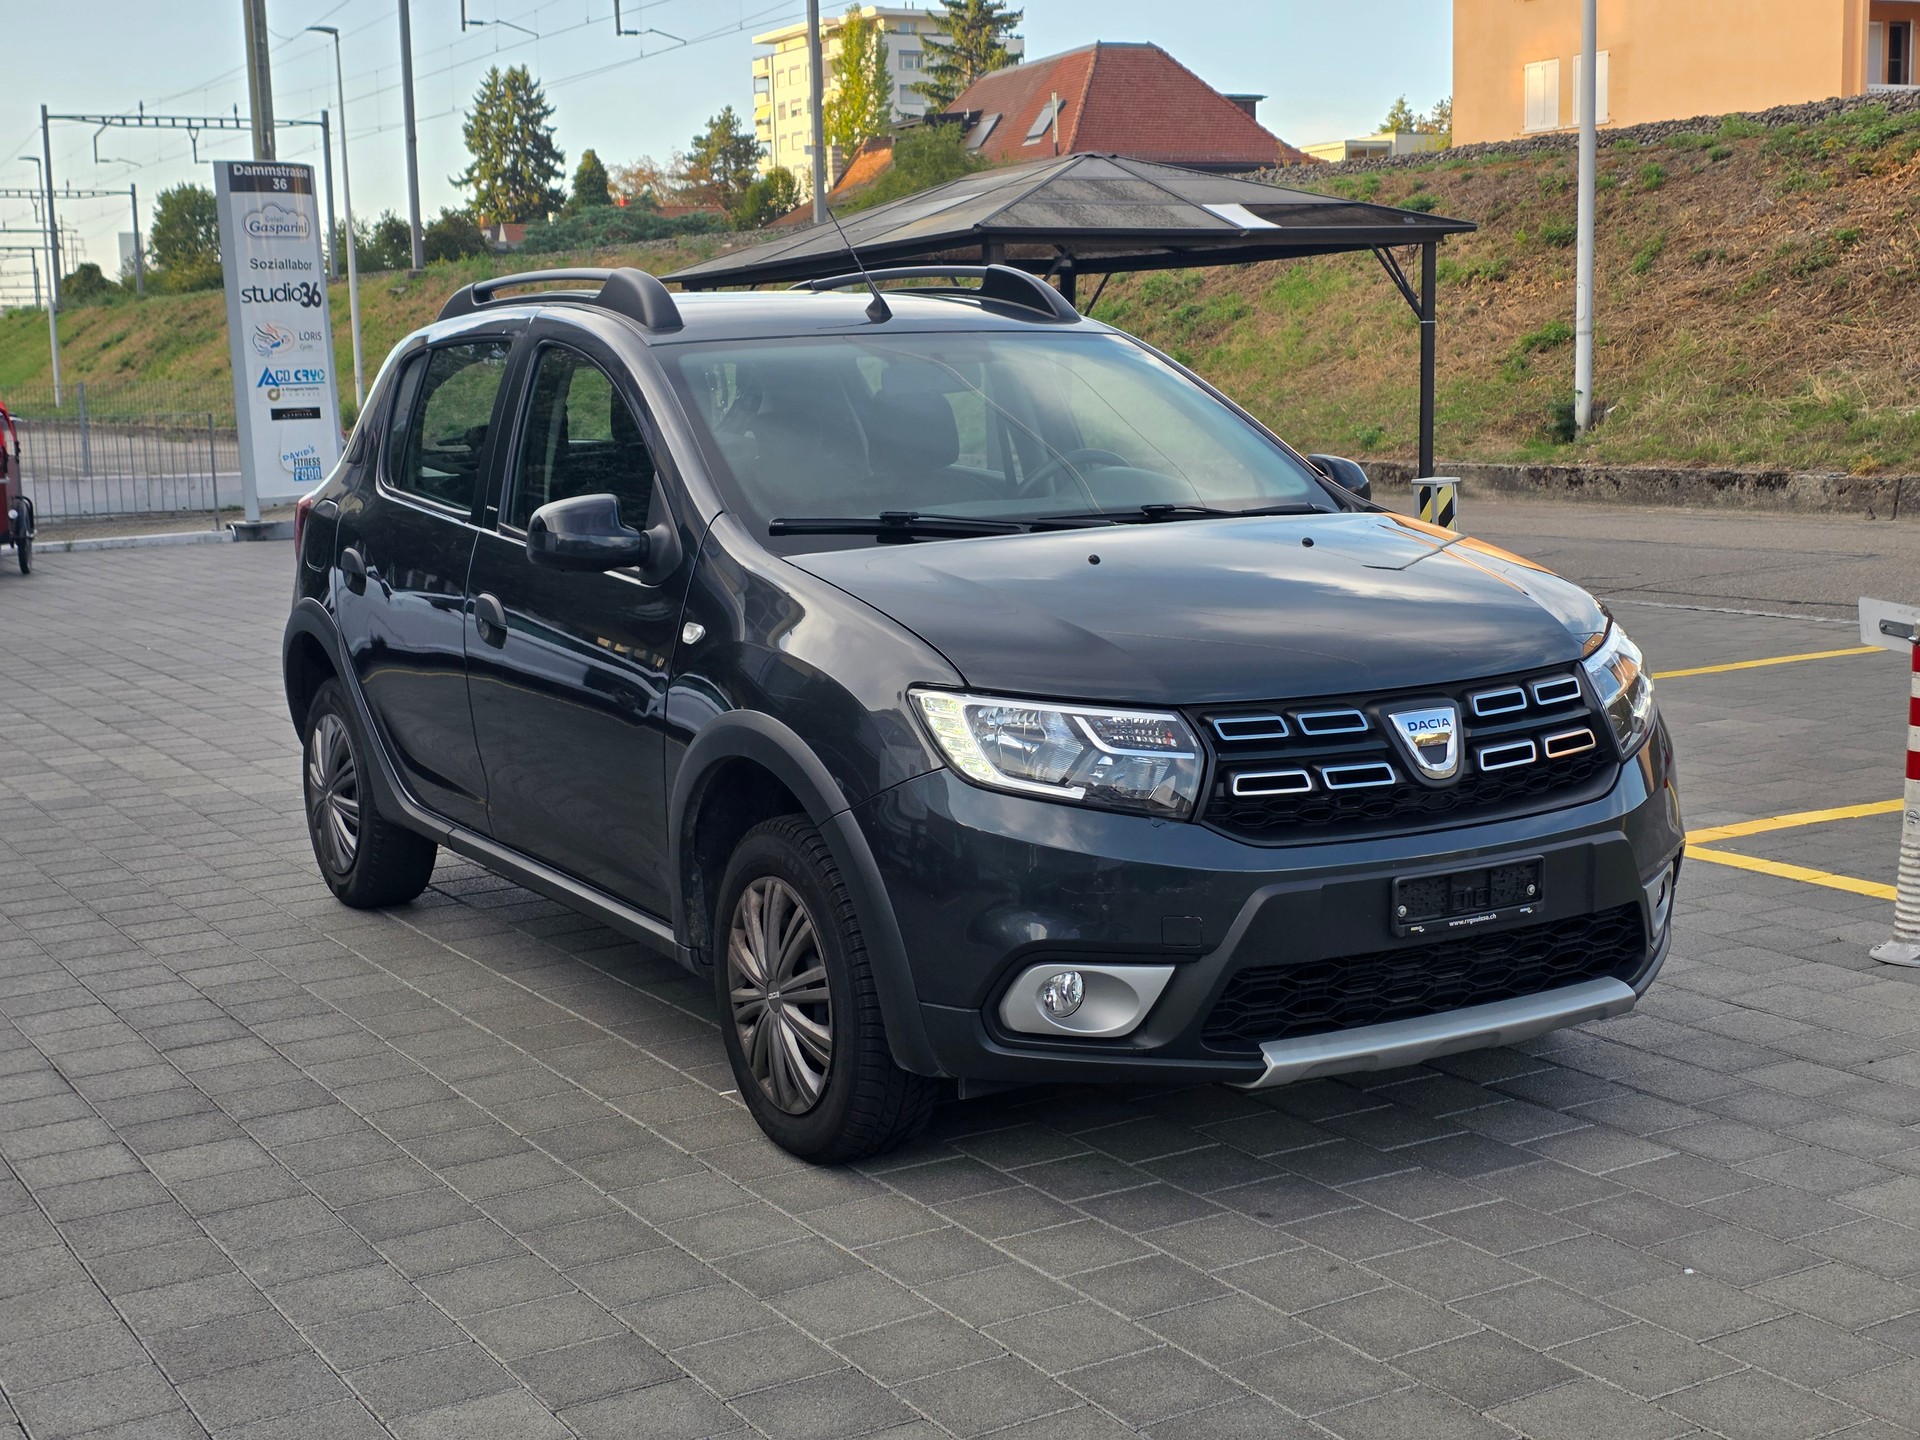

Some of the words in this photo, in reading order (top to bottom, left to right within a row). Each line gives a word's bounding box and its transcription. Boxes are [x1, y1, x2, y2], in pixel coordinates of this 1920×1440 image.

[233, 164, 308, 178] Dammstrasse
[272, 178, 288, 190] 36
[249, 220, 307, 234] Gasparini
[250, 258, 312, 270] Soziallabor
[241, 282, 321, 308] studio36
[299, 331, 322, 341] LORIS
[294, 369, 325, 381] CRYO
[294, 457, 321, 467] FITNESS
[294, 467, 321, 480] FOOD
[1407, 718, 1451, 731] DACIA
